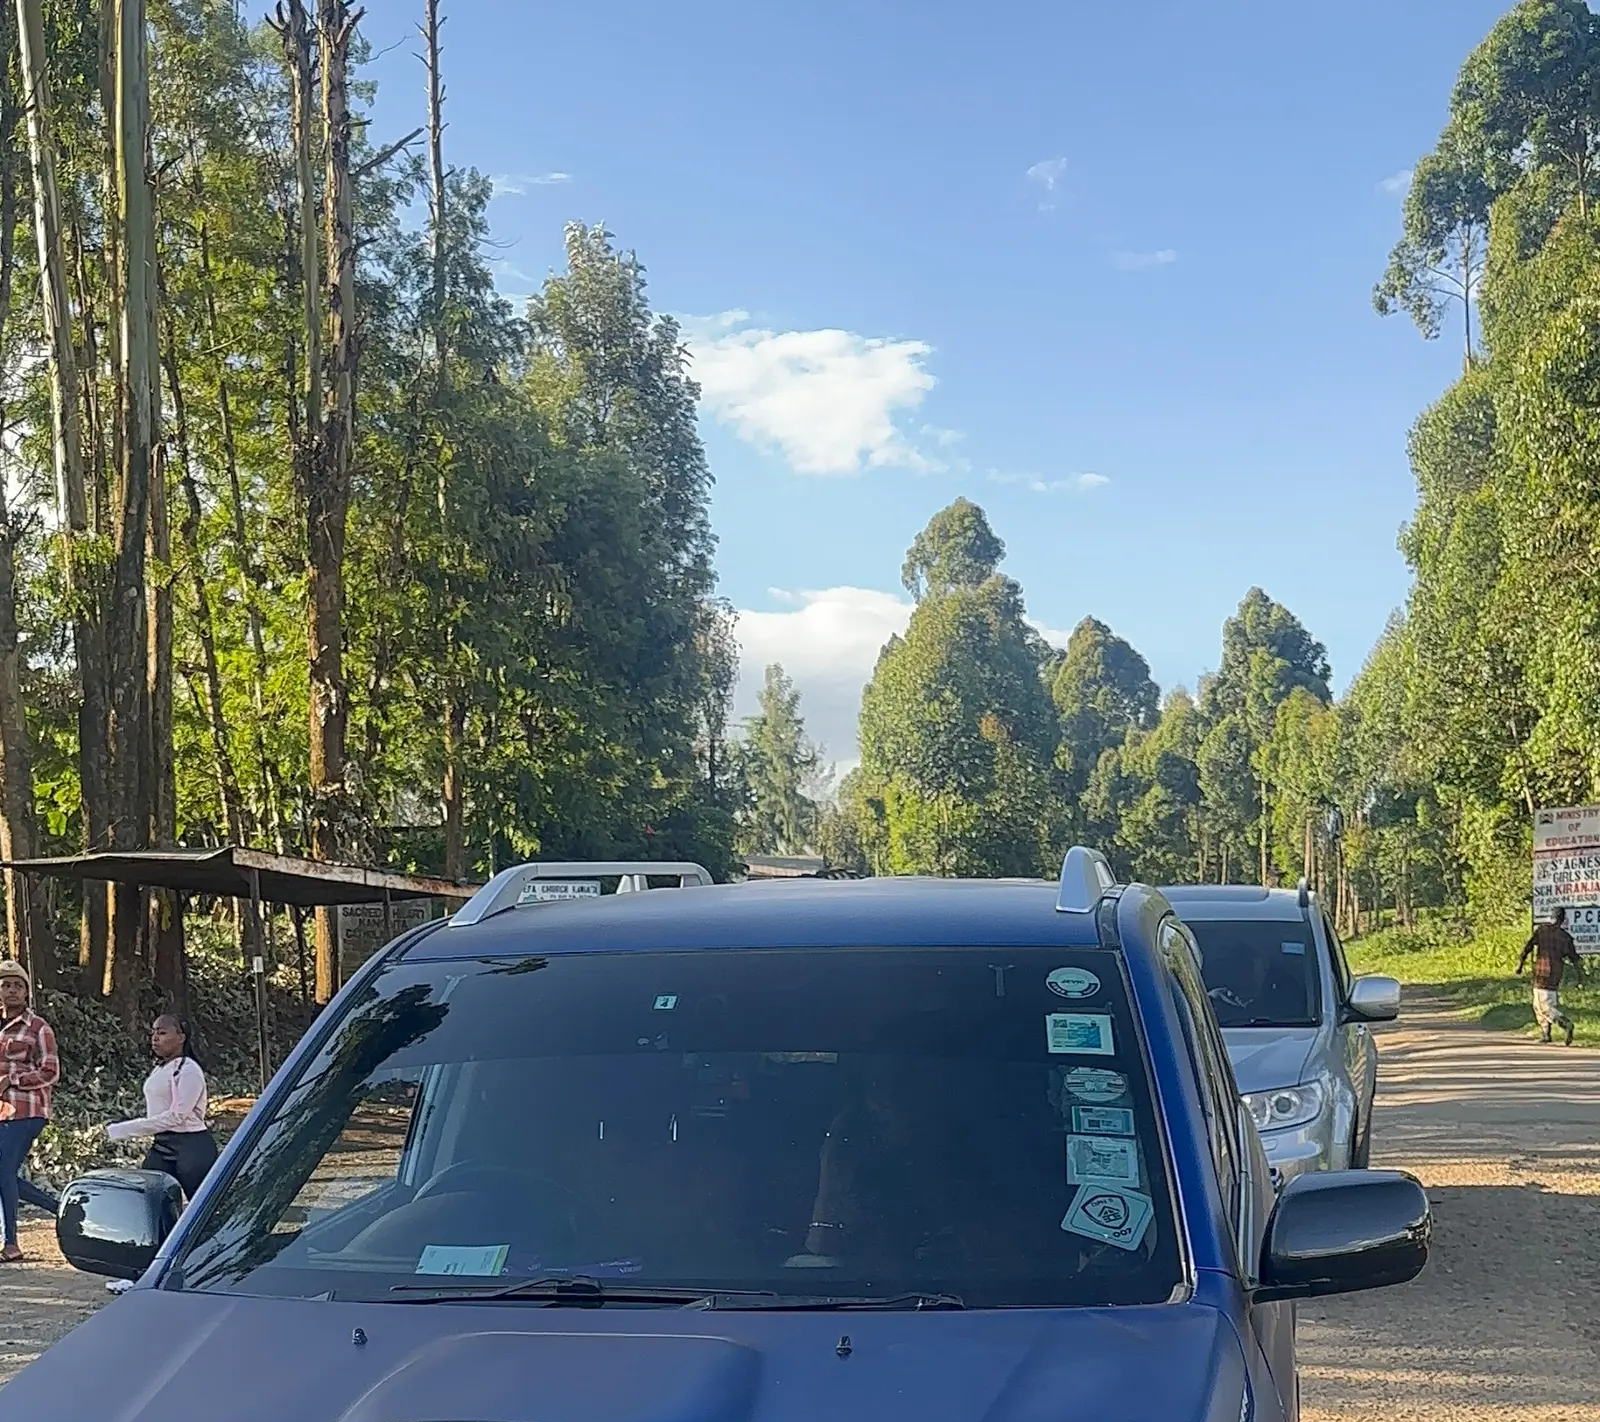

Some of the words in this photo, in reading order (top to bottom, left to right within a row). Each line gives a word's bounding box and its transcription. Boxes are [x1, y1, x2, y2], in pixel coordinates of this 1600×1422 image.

[1556, 809, 1599, 820] MINISTRY
[1568, 822, 1581, 832] OF
[1545, 834, 1600, 847] EDUCATION
[1564, 855, 1600, 870] AGNES
[1553, 870, 1581, 883] GIRLS
[1535, 885, 1553, 898] SCH
[1112, 1228, 1132, 1238] 007
